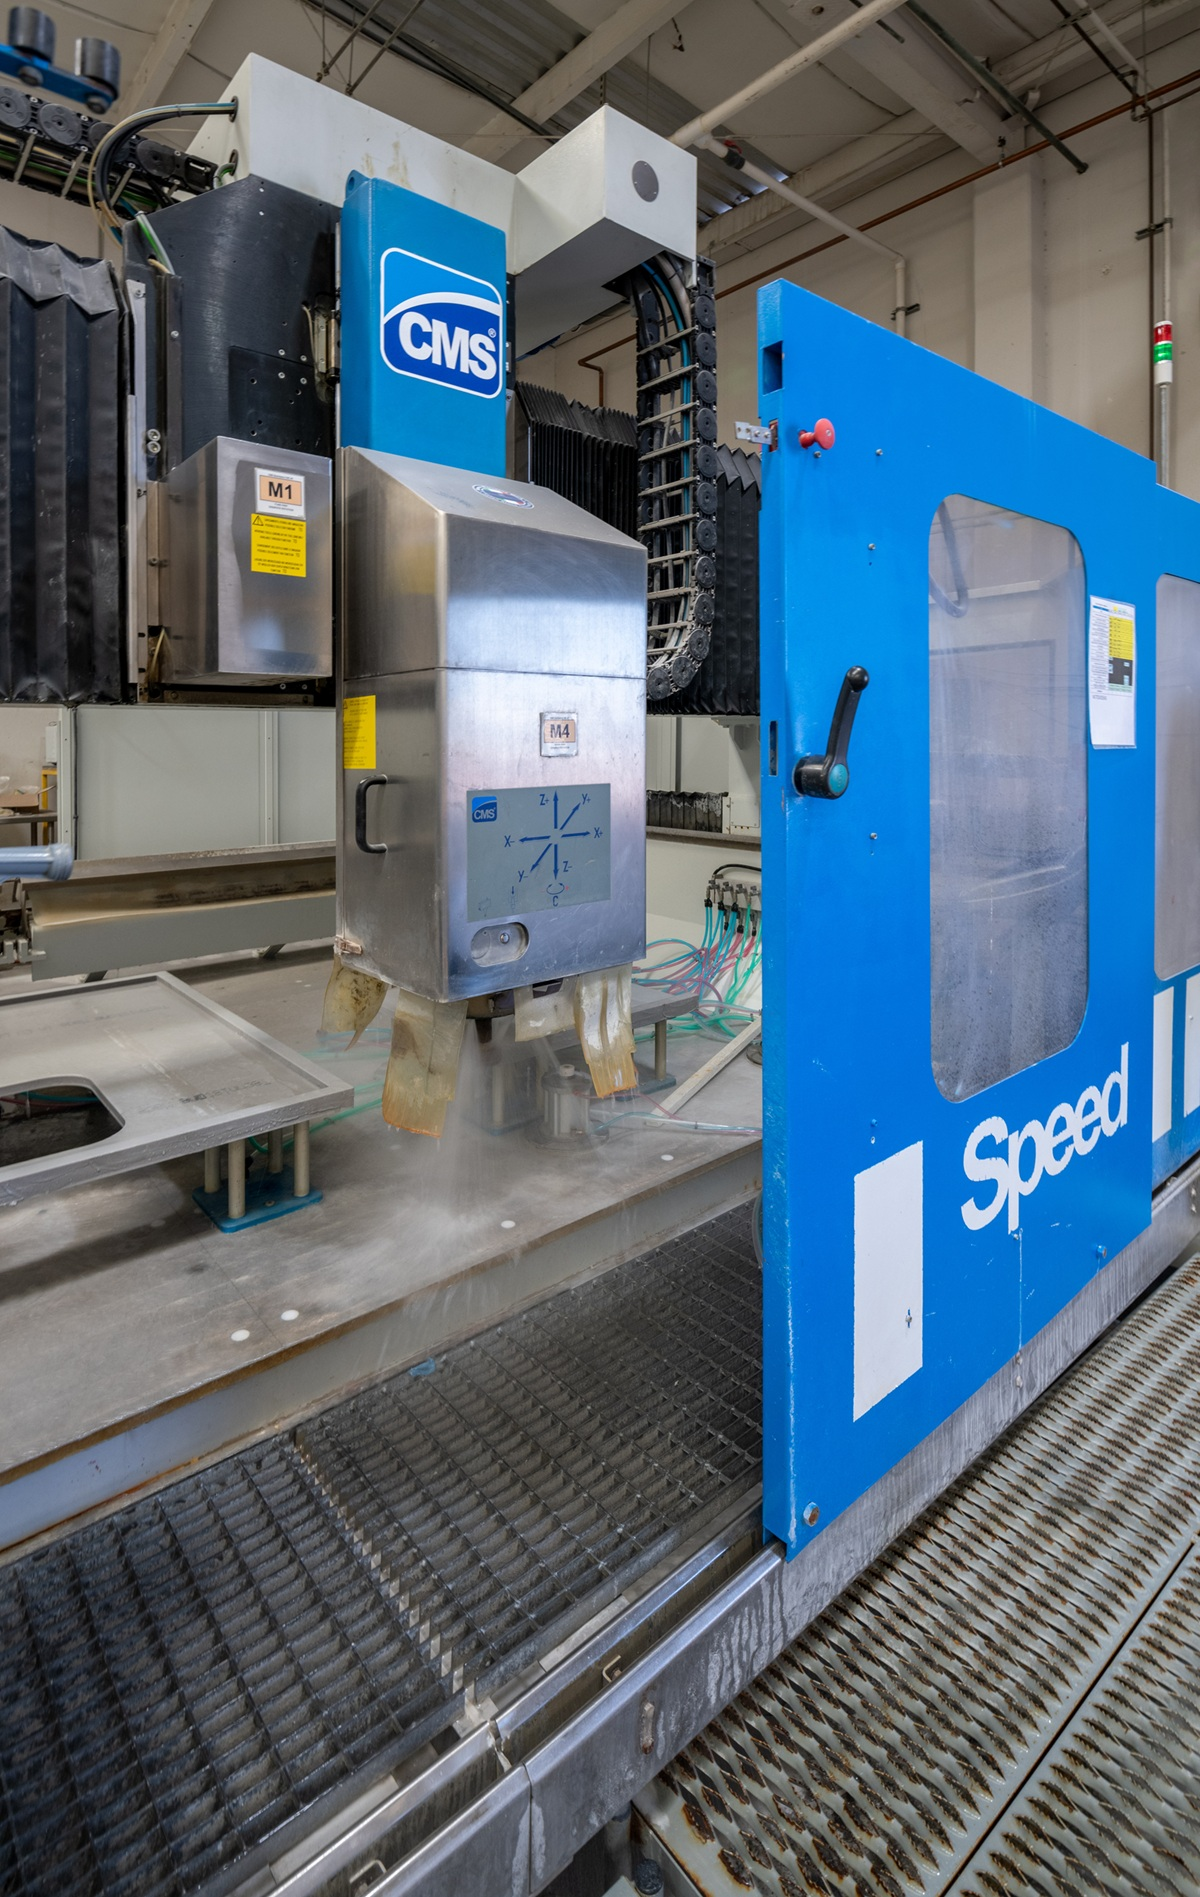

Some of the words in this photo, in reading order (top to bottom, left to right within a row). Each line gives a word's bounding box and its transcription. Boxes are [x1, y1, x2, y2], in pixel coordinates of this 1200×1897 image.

[268, 481, 292, 500] M1
[550, 723, 570, 738] M4
[552, 895, 559, 907] C
[960, 1041, 1130, 1236] Speed
